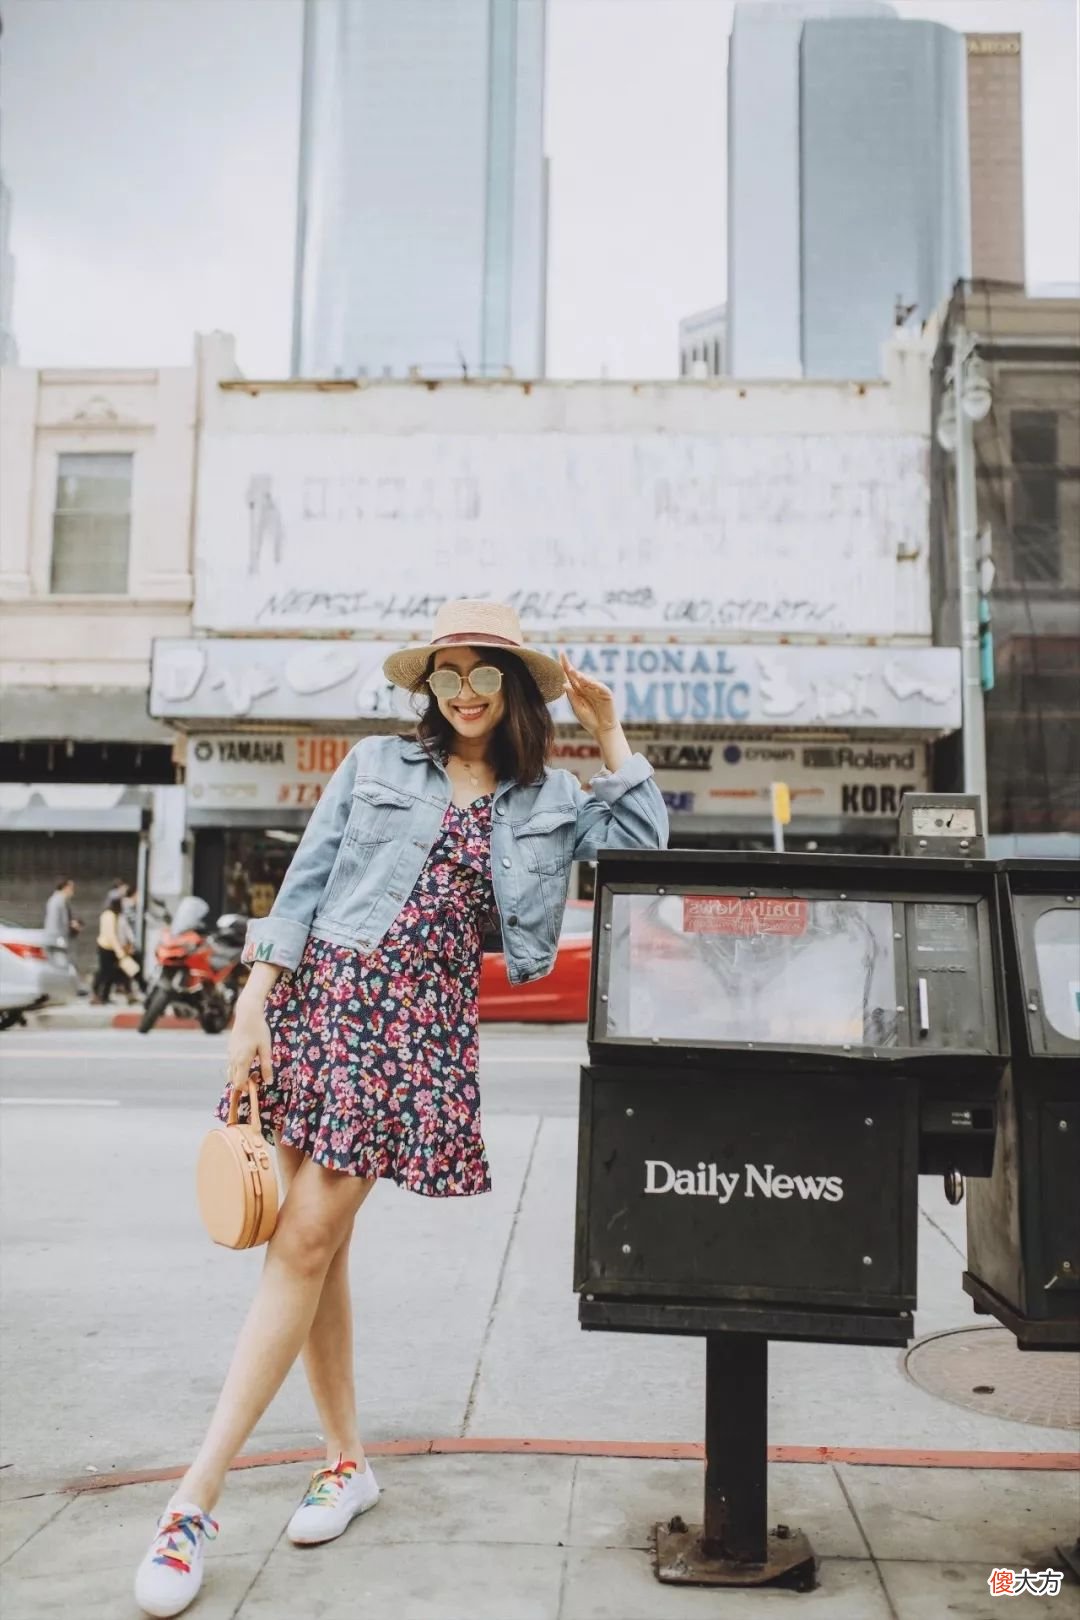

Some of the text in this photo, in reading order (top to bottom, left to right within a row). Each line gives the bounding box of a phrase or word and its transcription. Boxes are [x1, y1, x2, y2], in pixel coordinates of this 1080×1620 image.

[624, 681, 750, 720] MUSIC
[217, 740, 284, 763] YAMAHA
[838, 748, 915, 769] Roland
[644, 1160, 844, 1204] Daily News
